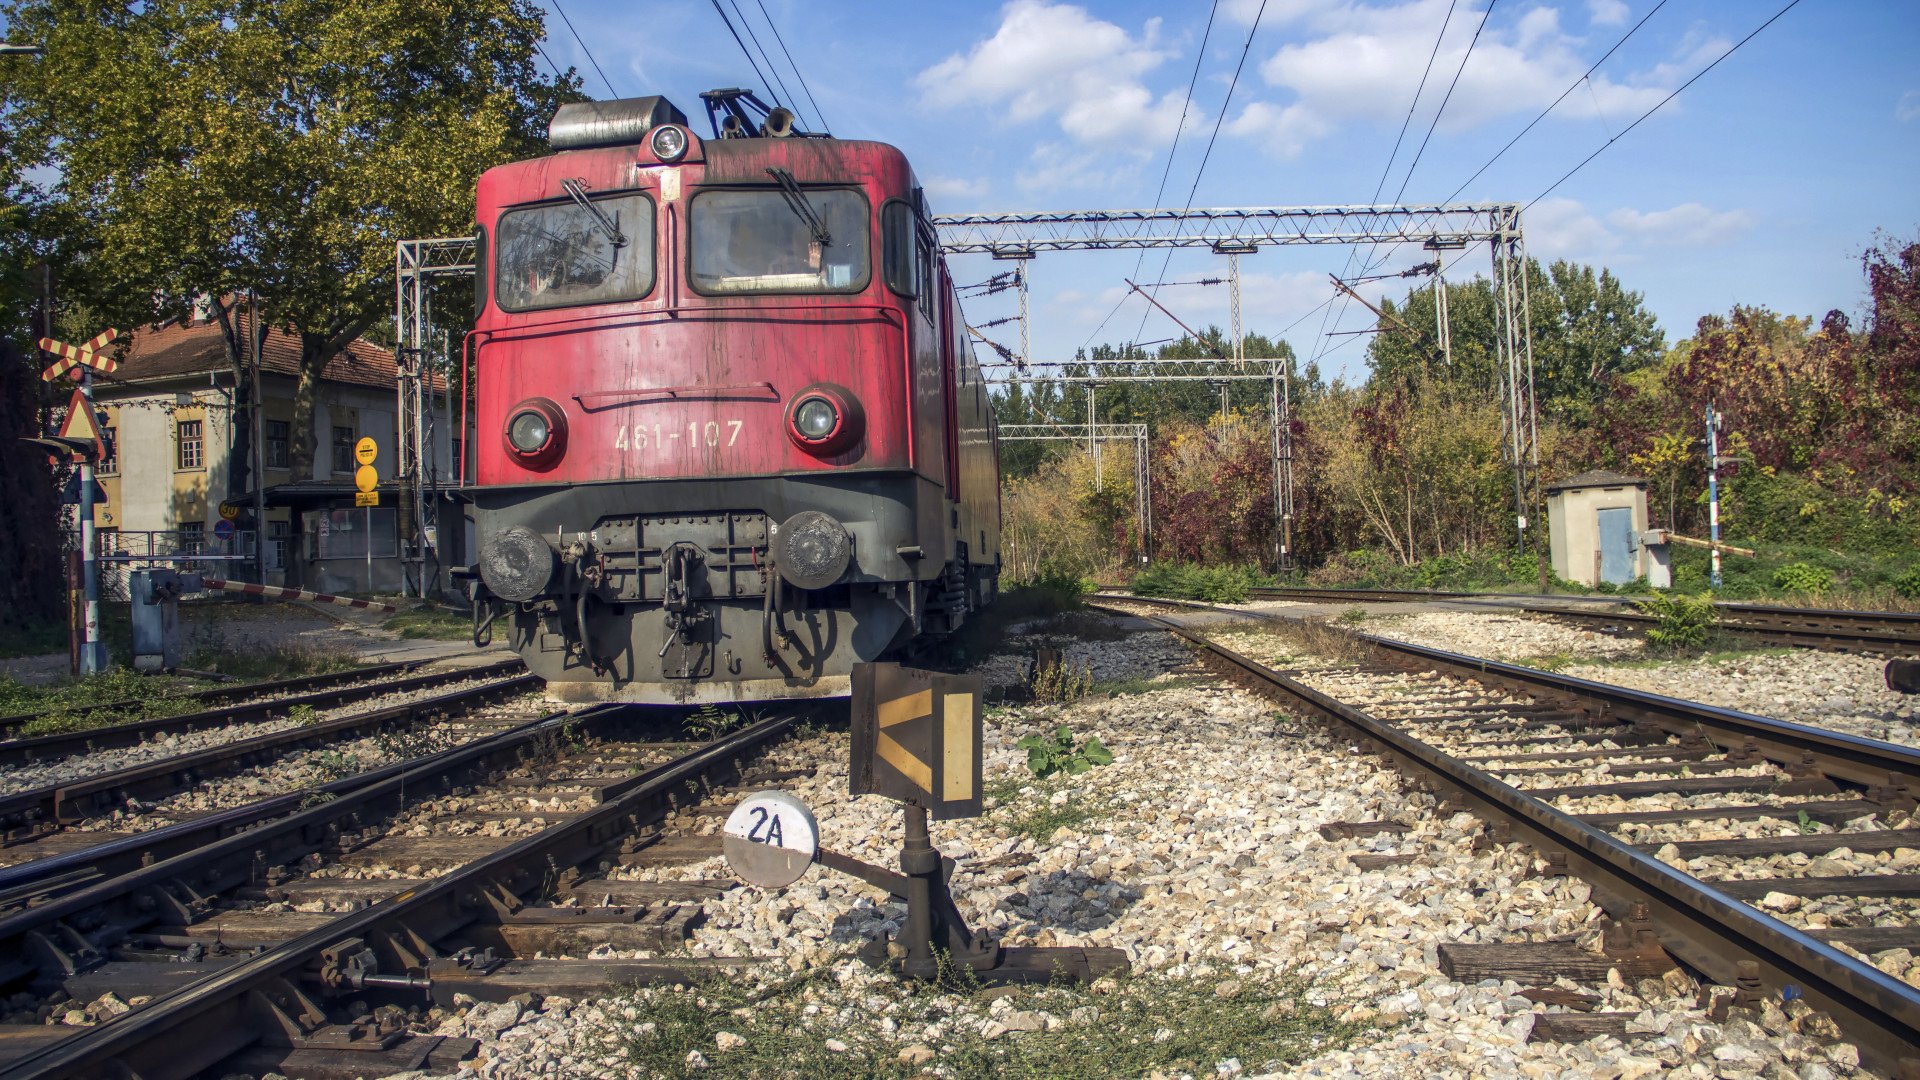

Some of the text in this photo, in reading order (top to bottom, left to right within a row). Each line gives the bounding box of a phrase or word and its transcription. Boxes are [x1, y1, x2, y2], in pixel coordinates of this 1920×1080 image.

[615, 420, 742, 451] 461-107
[577, 531, 597, 541] 10 5
[771, 525, 777, 534] 5
[748, 806, 783, 848] 2A
